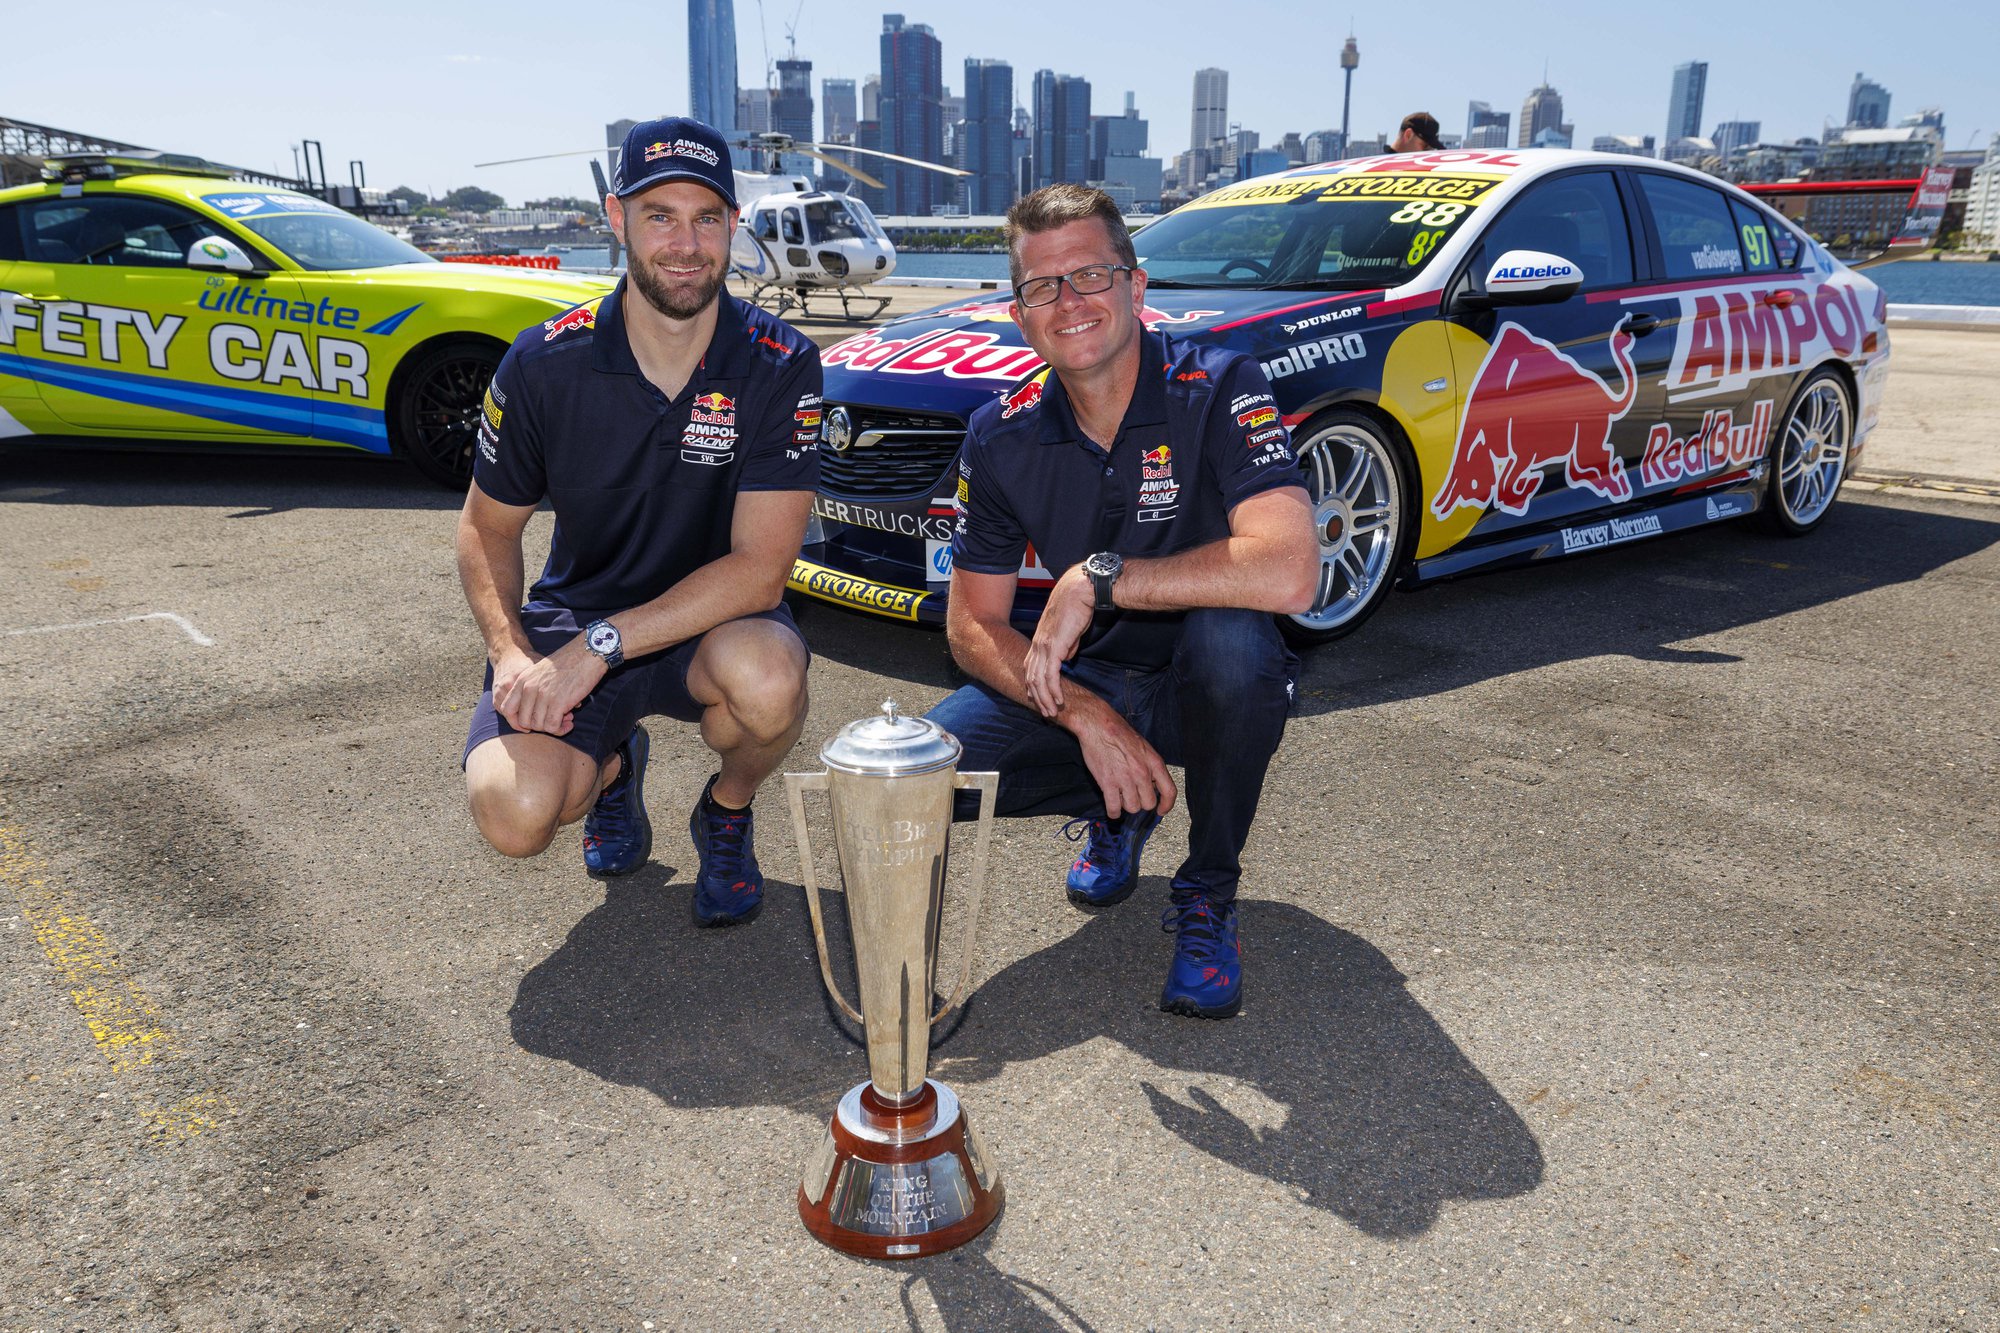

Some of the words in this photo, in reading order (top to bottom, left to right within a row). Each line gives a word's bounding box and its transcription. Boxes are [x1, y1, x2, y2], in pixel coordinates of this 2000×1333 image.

[673, 146, 719, 166] RACING
[675, 138, 719, 160] AMPOL
[1324, 177, 1491, 198] STORAGE
[1389, 200, 1467, 227] 88
[1742, 224, 1770, 266] 97
[206, 276, 225, 289] bp
[1495, 265, 1571, 279] ACDelco
[198, 285, 360, 330] ultimate
[1296, 306, 1362, 330] DUNLOP
[0, 289, 188, 371] FETY
[208, 322, 369, 400] CAR
[1679, 284, 1878, 384] AMPOL
[1254, 414, 1274, 424] AUTO
[682, 434, 736, 447] RACING
[683, 423, 739, 438] AMPOL
[701, 454, 715, 463] SVG
[786, 449, 800, 460] TW
[1252, 454, 1270, 466] TW
[1140, 479, 1180, 492] AMPOL
[850, 504, 952, 542] TRUCKS
[1560, 525, 1609, 547] Harvey
[1609, 514, 1662, 539] Norman
[812, 572, 914, 612] STORAGE
